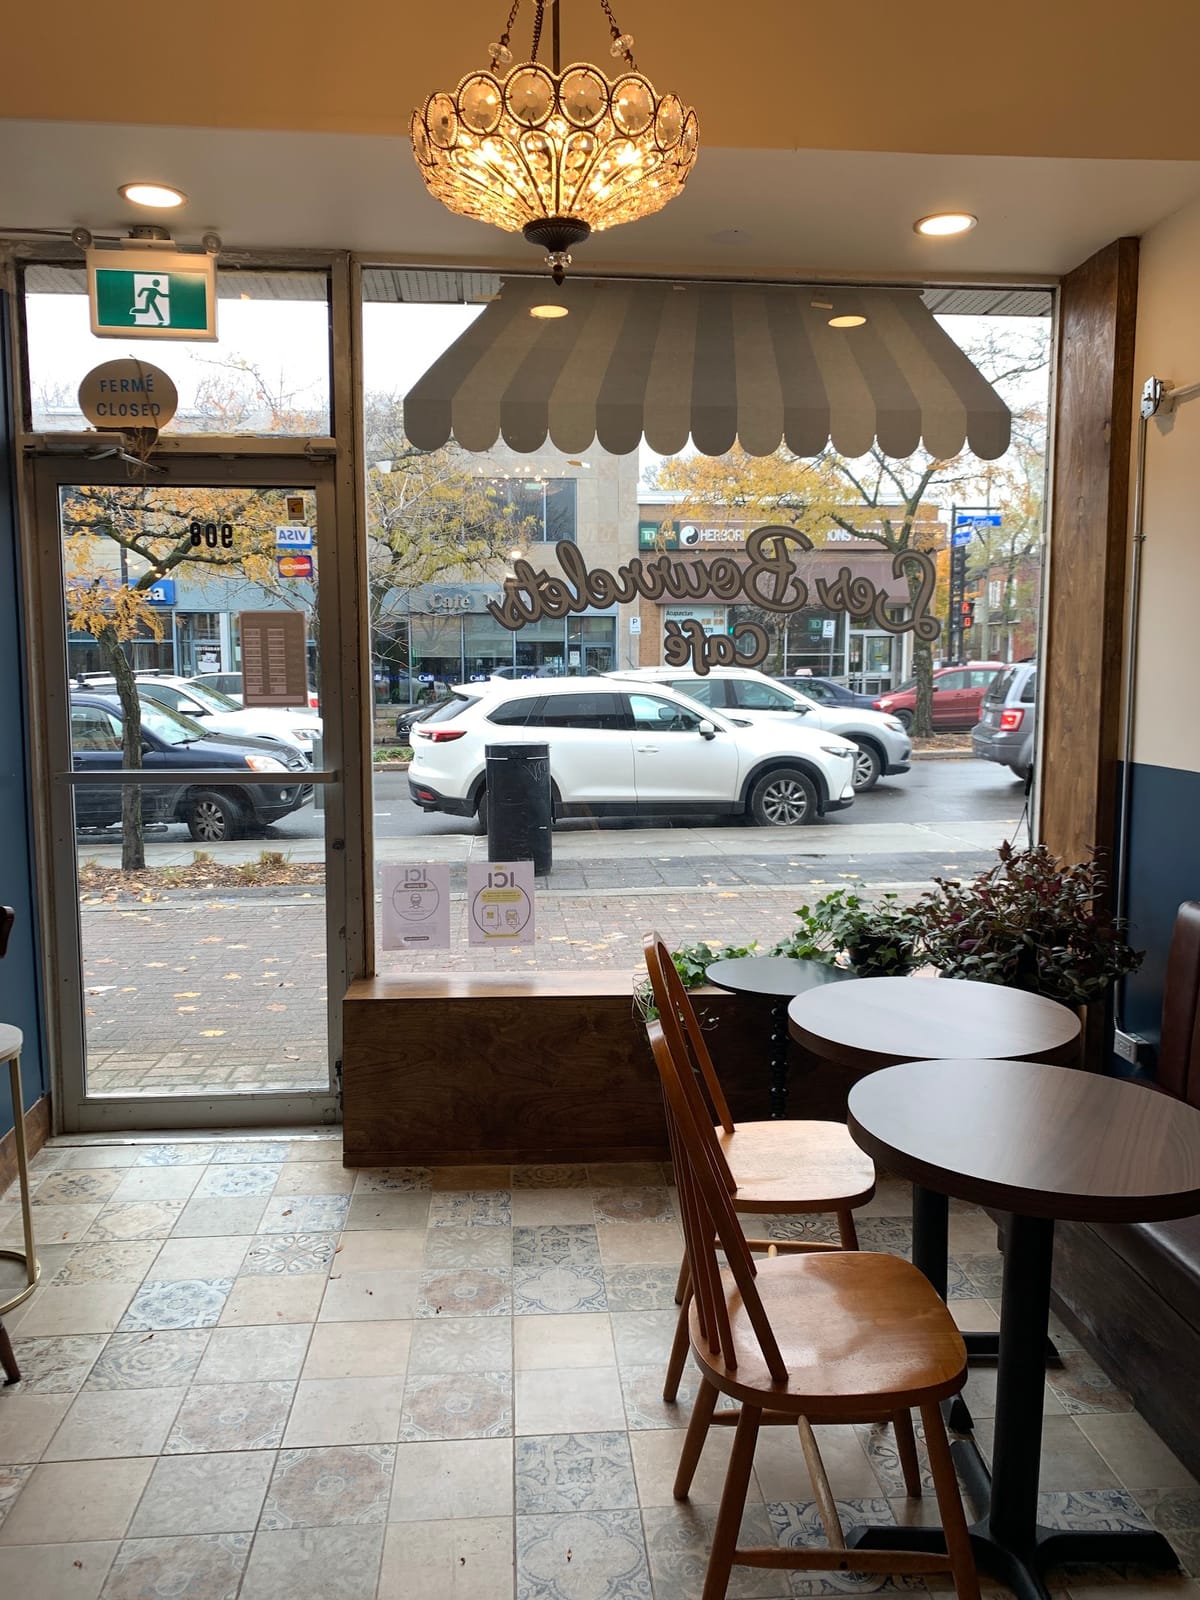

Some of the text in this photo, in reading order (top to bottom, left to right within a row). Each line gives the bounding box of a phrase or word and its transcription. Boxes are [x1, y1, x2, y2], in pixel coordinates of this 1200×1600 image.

[100, 373, 154, 392] FERMÉ
[96, 402, 161, 417] CLOSED
[641, 530, 656, 540] TD
[430, 592, 470, 610] Café
